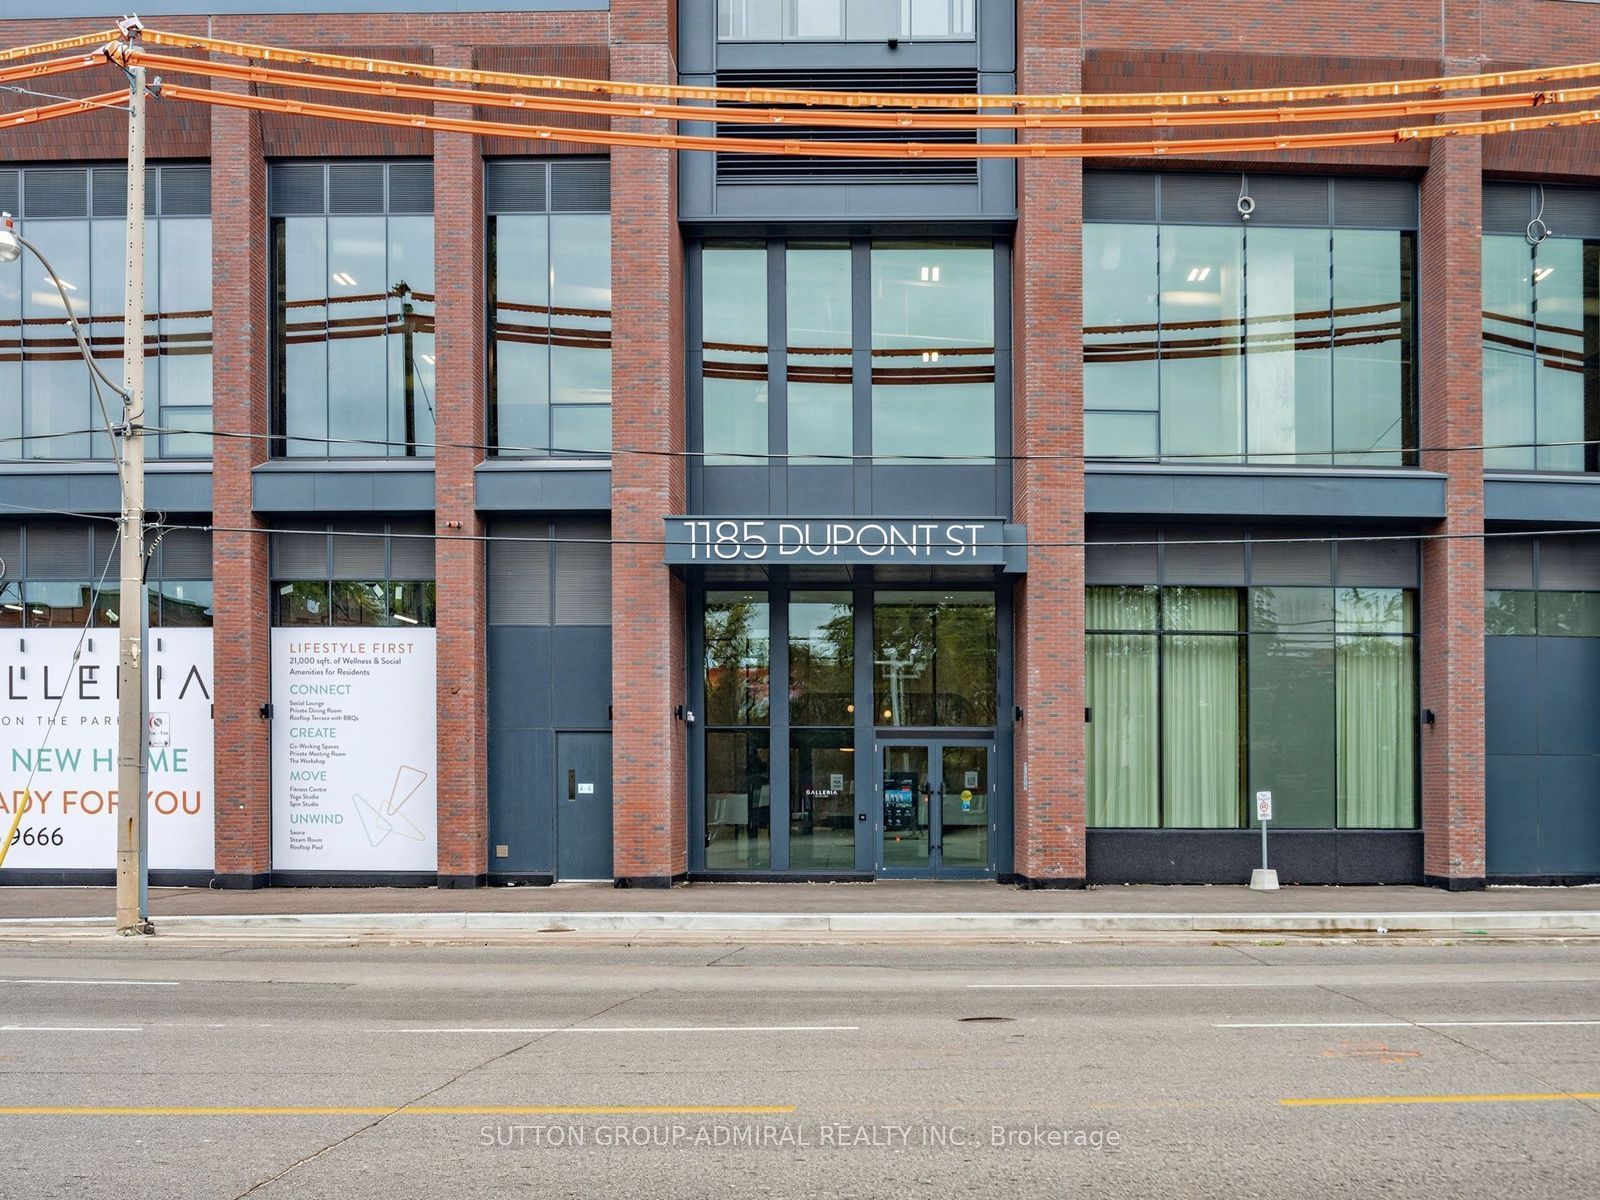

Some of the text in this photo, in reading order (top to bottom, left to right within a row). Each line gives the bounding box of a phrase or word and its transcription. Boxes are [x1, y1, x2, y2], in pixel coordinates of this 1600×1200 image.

[684, 521, 984, 559] 1185 DUPONT ST
[290, 642, 414, 654] LIFESTYLE FIRST
[289, 657, 402, 667] 21,000 sqft. of Wellness & Social
[289, 668, 370, 676] Amenities for Residents
[9, 665, 210, 700] LLEIA
[289, 684, 351, 695] CONNECT
[308, 707, 326, 715] Dining
[2, 716, 119, 726] ON THE PAR
[289, 727, 336, 738] CREATE
[289, 743, 339, 751] Co-Working Spaces
[12, 748, 188, 772] NEW HME
[289, 770, 327, 781] MOVE
[147, 790, 201, 814] OU
[290, 813, 344, 824] UNWIND
